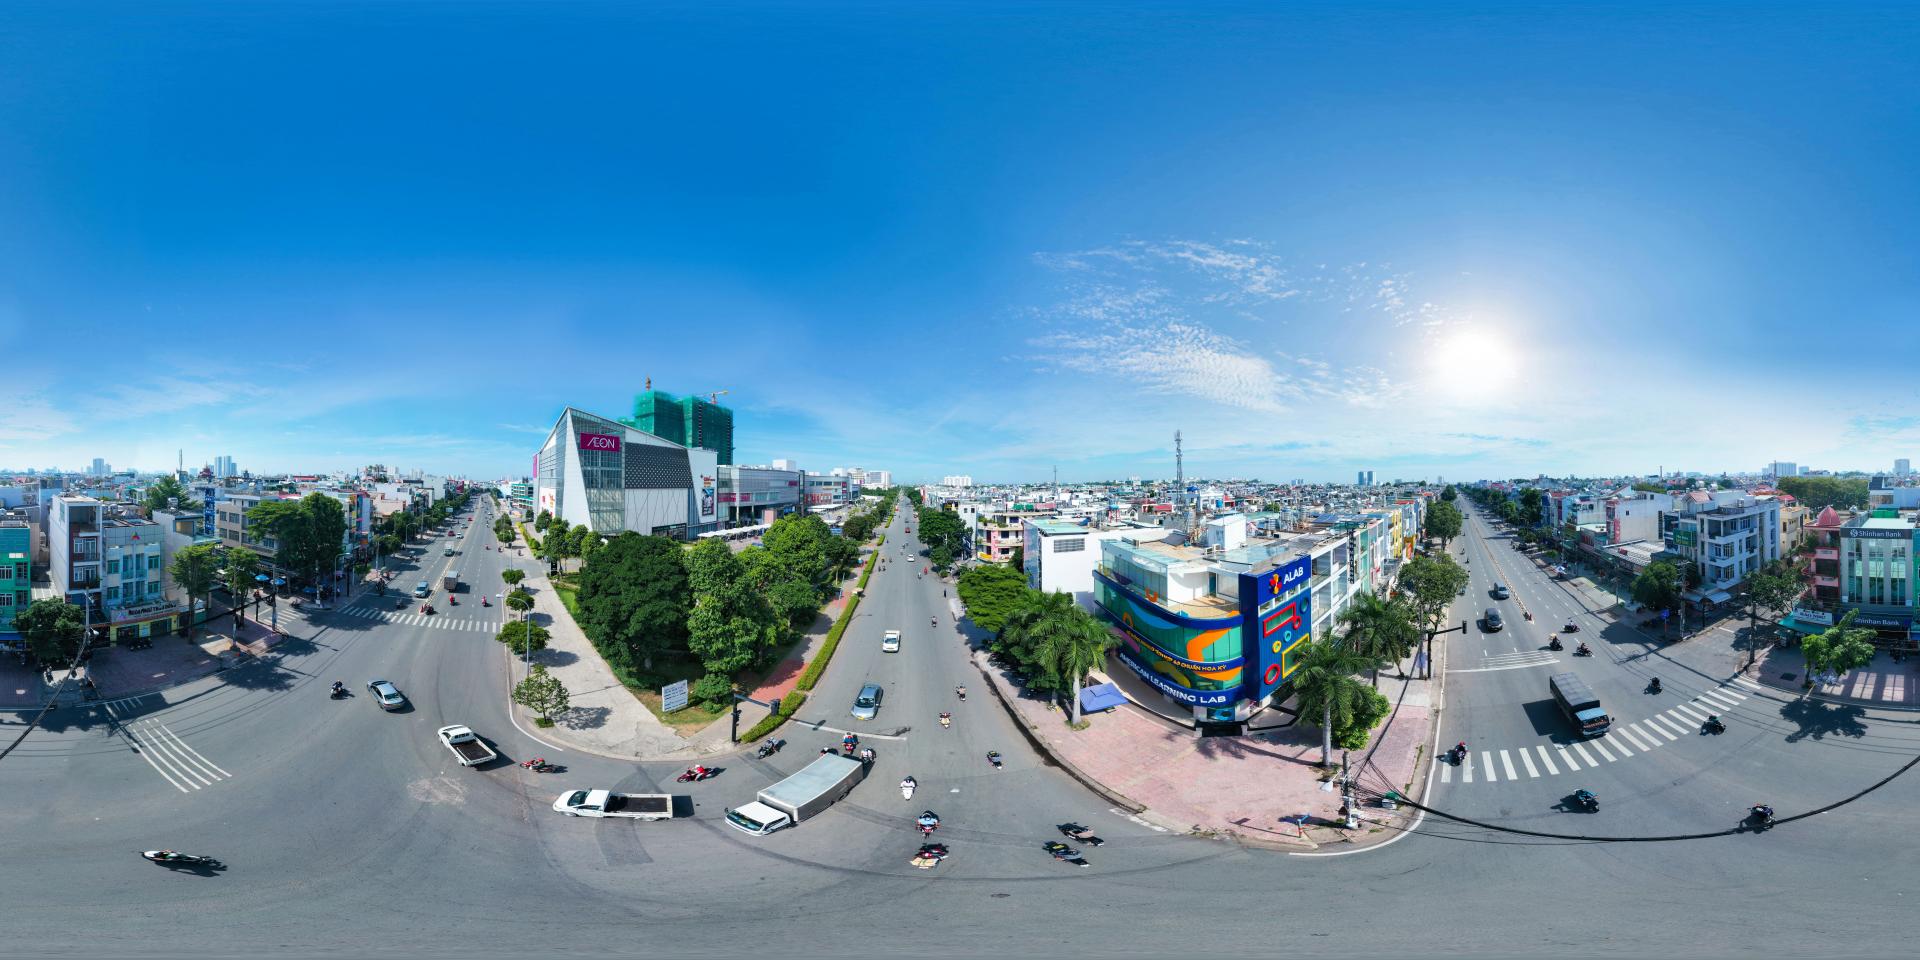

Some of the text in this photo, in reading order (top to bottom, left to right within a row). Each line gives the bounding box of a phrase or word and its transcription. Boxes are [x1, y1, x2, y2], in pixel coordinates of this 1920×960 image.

[1858, 530, 1902, 538] Shinhan Bank
[1283, 566, 1304, 585] ALAB
[1119, 652, 1227, 704] AMERICAN LEARNING LAB
